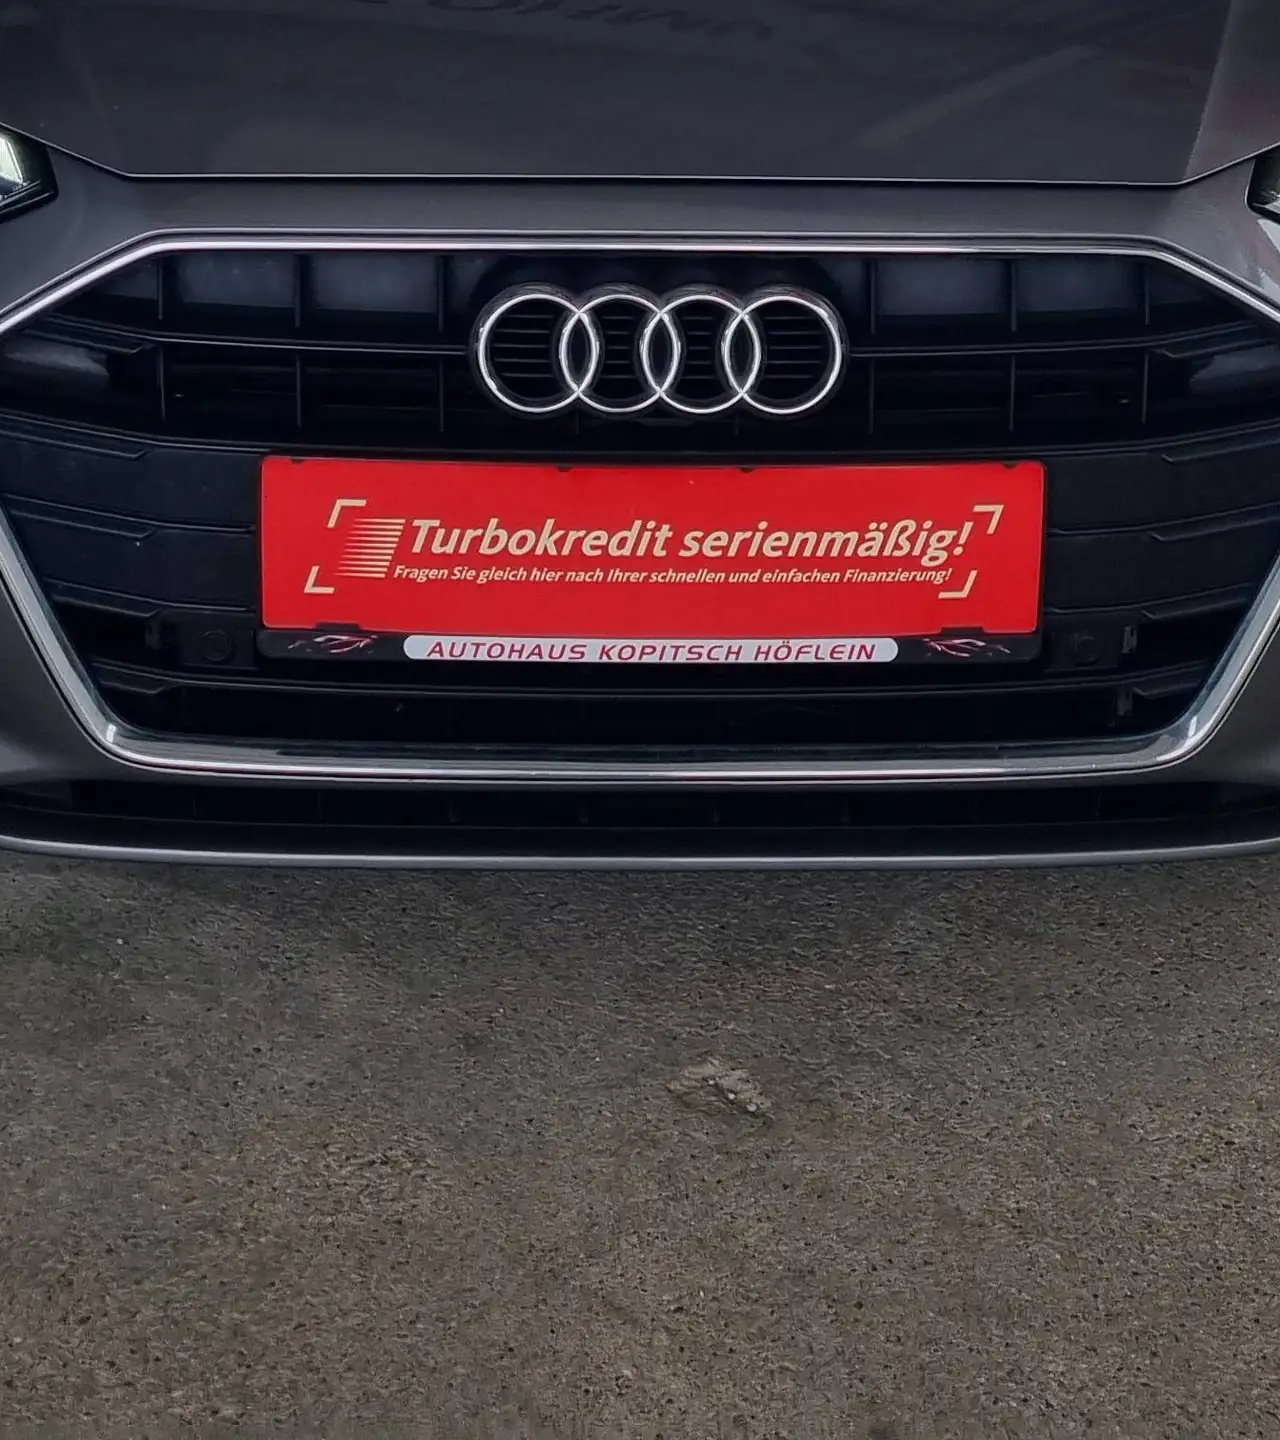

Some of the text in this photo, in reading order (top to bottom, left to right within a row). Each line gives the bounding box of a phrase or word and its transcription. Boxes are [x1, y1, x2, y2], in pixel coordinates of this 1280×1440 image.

[411, 517, 974, 568] Turbokredit serienmäßig!
[393, 564, 953, 586] Fragen Sie gleich hier nach Ihrer schnellen und einfachen Finanzierung!
[426, 640, 877, 662] AUTOHAUS KOPITSCH HÖFLEIN
